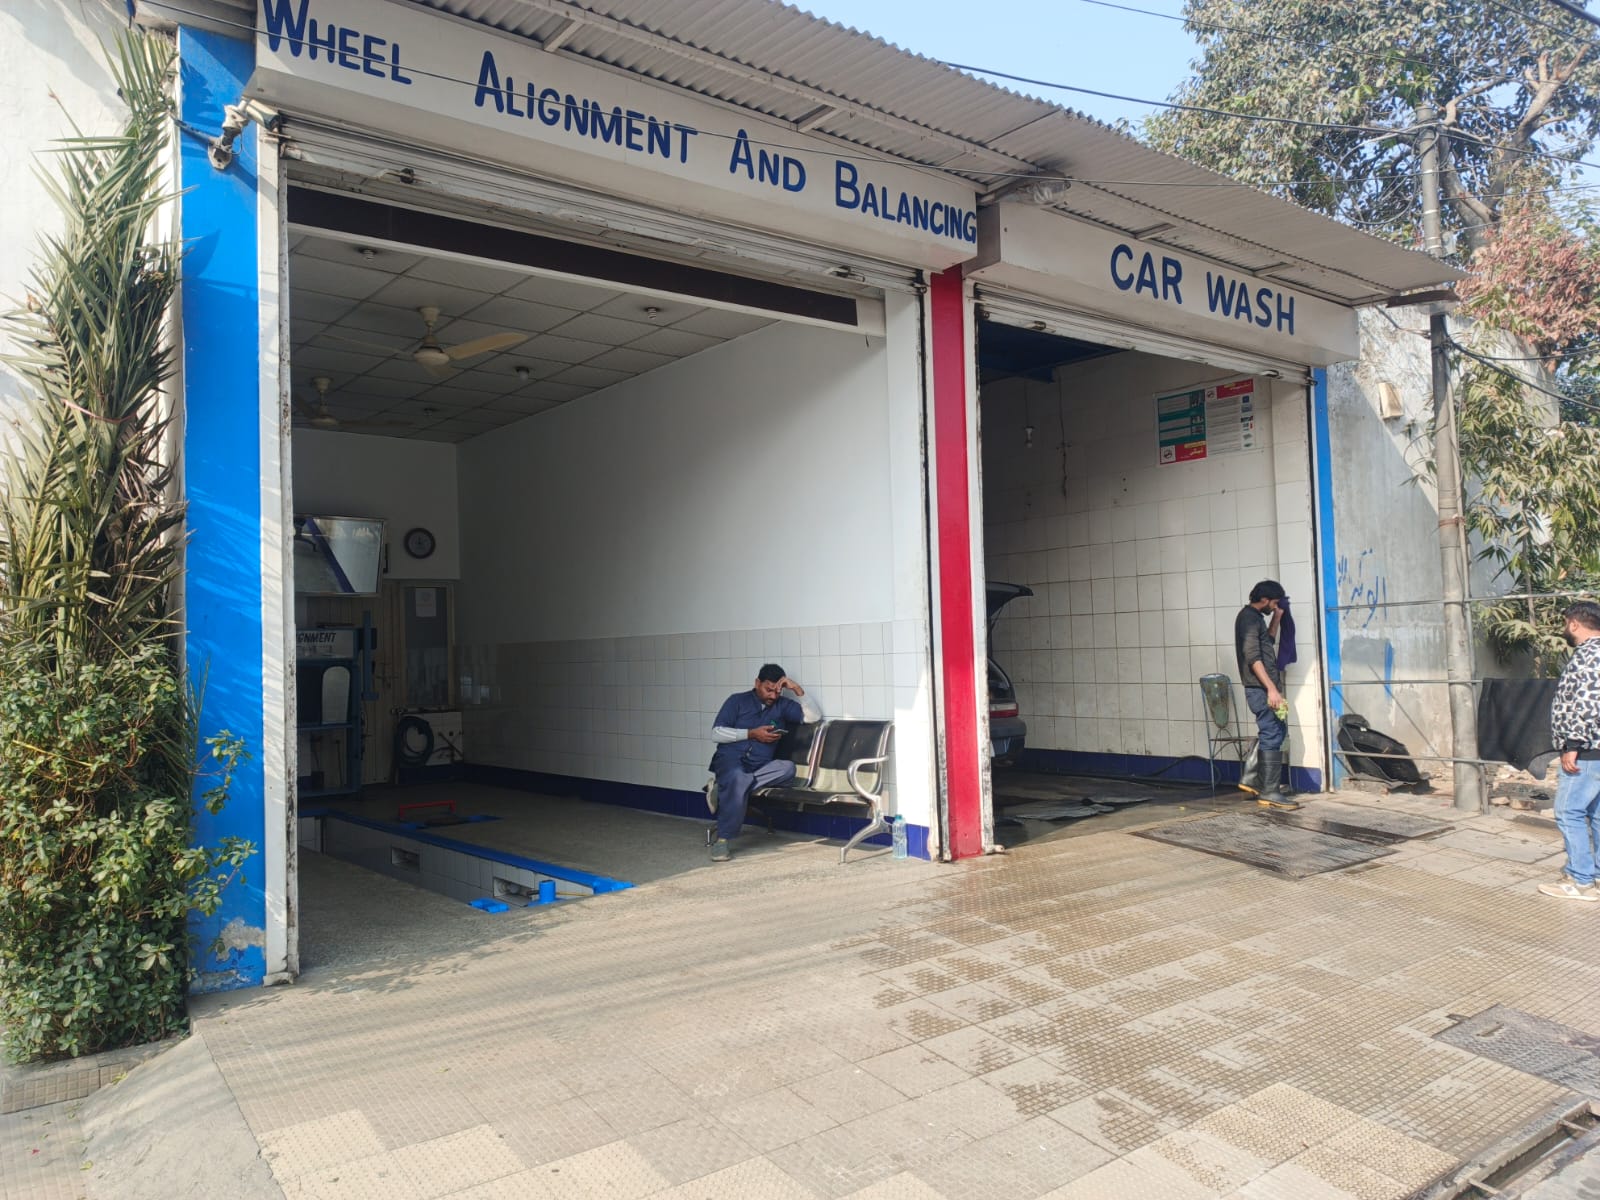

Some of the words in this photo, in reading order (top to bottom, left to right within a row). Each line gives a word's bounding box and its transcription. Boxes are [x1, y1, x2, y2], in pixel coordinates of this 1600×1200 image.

[475, 51, 698, 163] ALIGNMENT
[730, 129, 807, 193] AND
[835, 160, 978, 244] BALANCING
[1111, 244, 1182, 304] CAR
[1206, 272, 1295, 335] WASH
